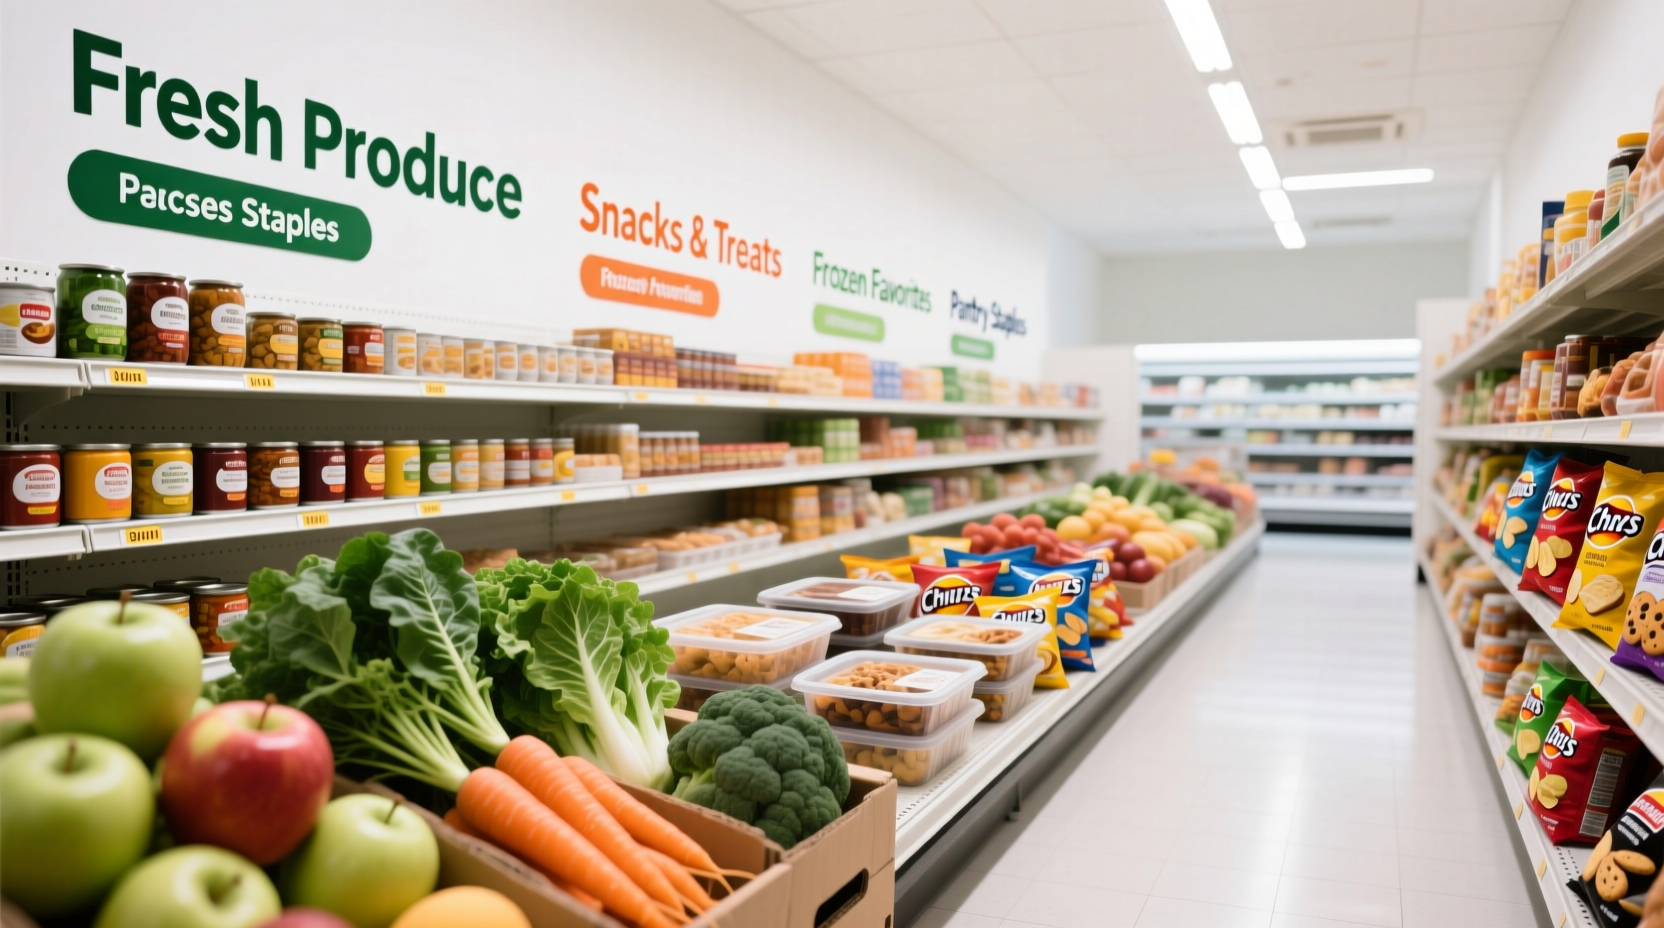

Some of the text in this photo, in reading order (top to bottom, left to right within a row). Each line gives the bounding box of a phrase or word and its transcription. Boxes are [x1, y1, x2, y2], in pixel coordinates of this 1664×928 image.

[73, 28, 523, 220] Fresh Produce
[241, 197, 339, 243] Staples
[579, 182, 783, 278] Snacks & Treats
[813, 250, 933, 315] Frozen Favorites
[950, 289, 988, 333] Pantry
